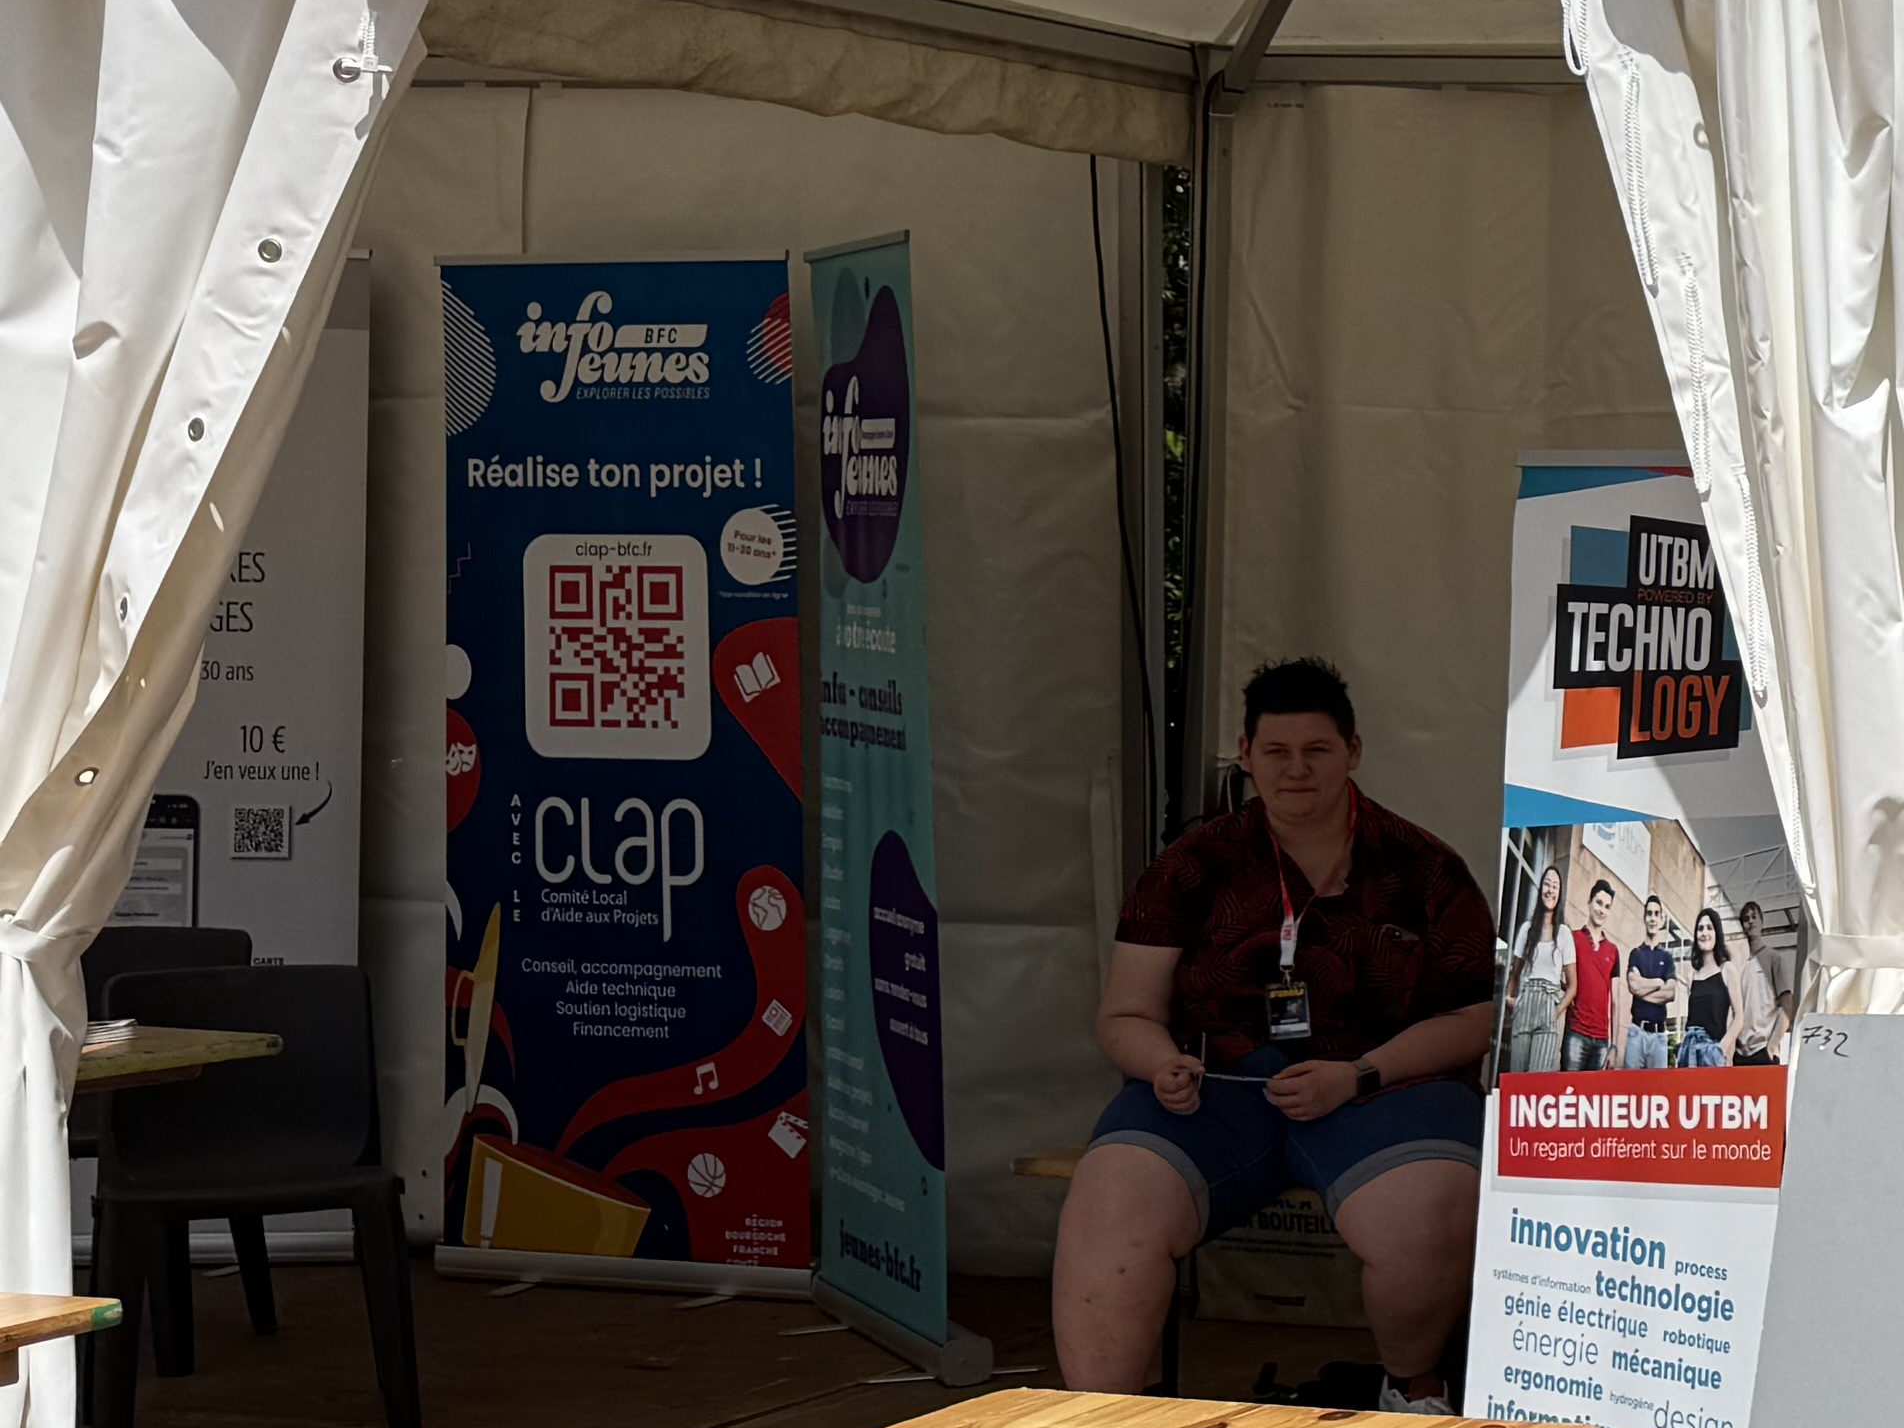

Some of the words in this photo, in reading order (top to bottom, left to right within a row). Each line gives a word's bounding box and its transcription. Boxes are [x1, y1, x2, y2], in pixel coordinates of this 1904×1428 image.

[644, 326, 678, 344] BFC
[632, 388, 651, 400] LES
[467, 454, 580, 489] Réalise
[588, 458, 641, 489] ton
[650, 455, 746, 498] projet
[754, 457, 762, 489] !
[575, 540, 652, 560] clap-bfc.fr
[1638, 532, 1716, 590] UTBM
[1638, 588, 1693, 604] POWERED
[1697, 592, 1714, 605] BY
[1567, 601, 1713, 673] TECHNO
[225, 663, 254, 682] ans
[1629, 669, 1731, 743] LOGY
[240, 725, 263, 753] 10
[272, 726, 286, 753] €
[203, 760, 234, 781] J'en
[238, 763, 277, 781] veux
[281, 763, 310, 781] une
[541, 888, 590, 905] Comité
[592, 890, 627, 905] Local
[586, 912, 611, 924] aux
[613, 910, 659, 928] Projets
[581, 961, 722, 980] accompagnement
[565, 980, 599, 995] Aide
[602, 981, 676, 1000] technique
[556, 1000, 611, 1016] Soutien
[614, 1002, 687, 1022] logistique
[572, 1021, 670, 1039] Financement
[1509, 1085, 1670, 1129] INGÉNIEUR
[1678, 1094, 1769, 1130] UTBM
[1509, 1137, 1529, 1157] Un
[1533, 1137, 1585, 1162] regard
[1590, 1137, 1656, 1160] différent
[1661, 1143, 1687, 1160] sur
[1693, 1138, 1707, 1160] le
[1711, 1139, 1772, 1161] monde
[1510, 1207, 1666, 1269] innovation
[1674, 1260, 1728, 1281] process
[1595, 1270, 1735, 1322] technologie
[1504, 1292, 1552, 1319] génie
[1557, 1300, 1649, 1338] électrique
[1663, 1329, 1731, 1354] robotique
[1512, 1321, 1599, 1367] énergie
[1612, 1348, 1722, 1390] mécanique
[1504, 1364, 1604, 1401] ergonomie
